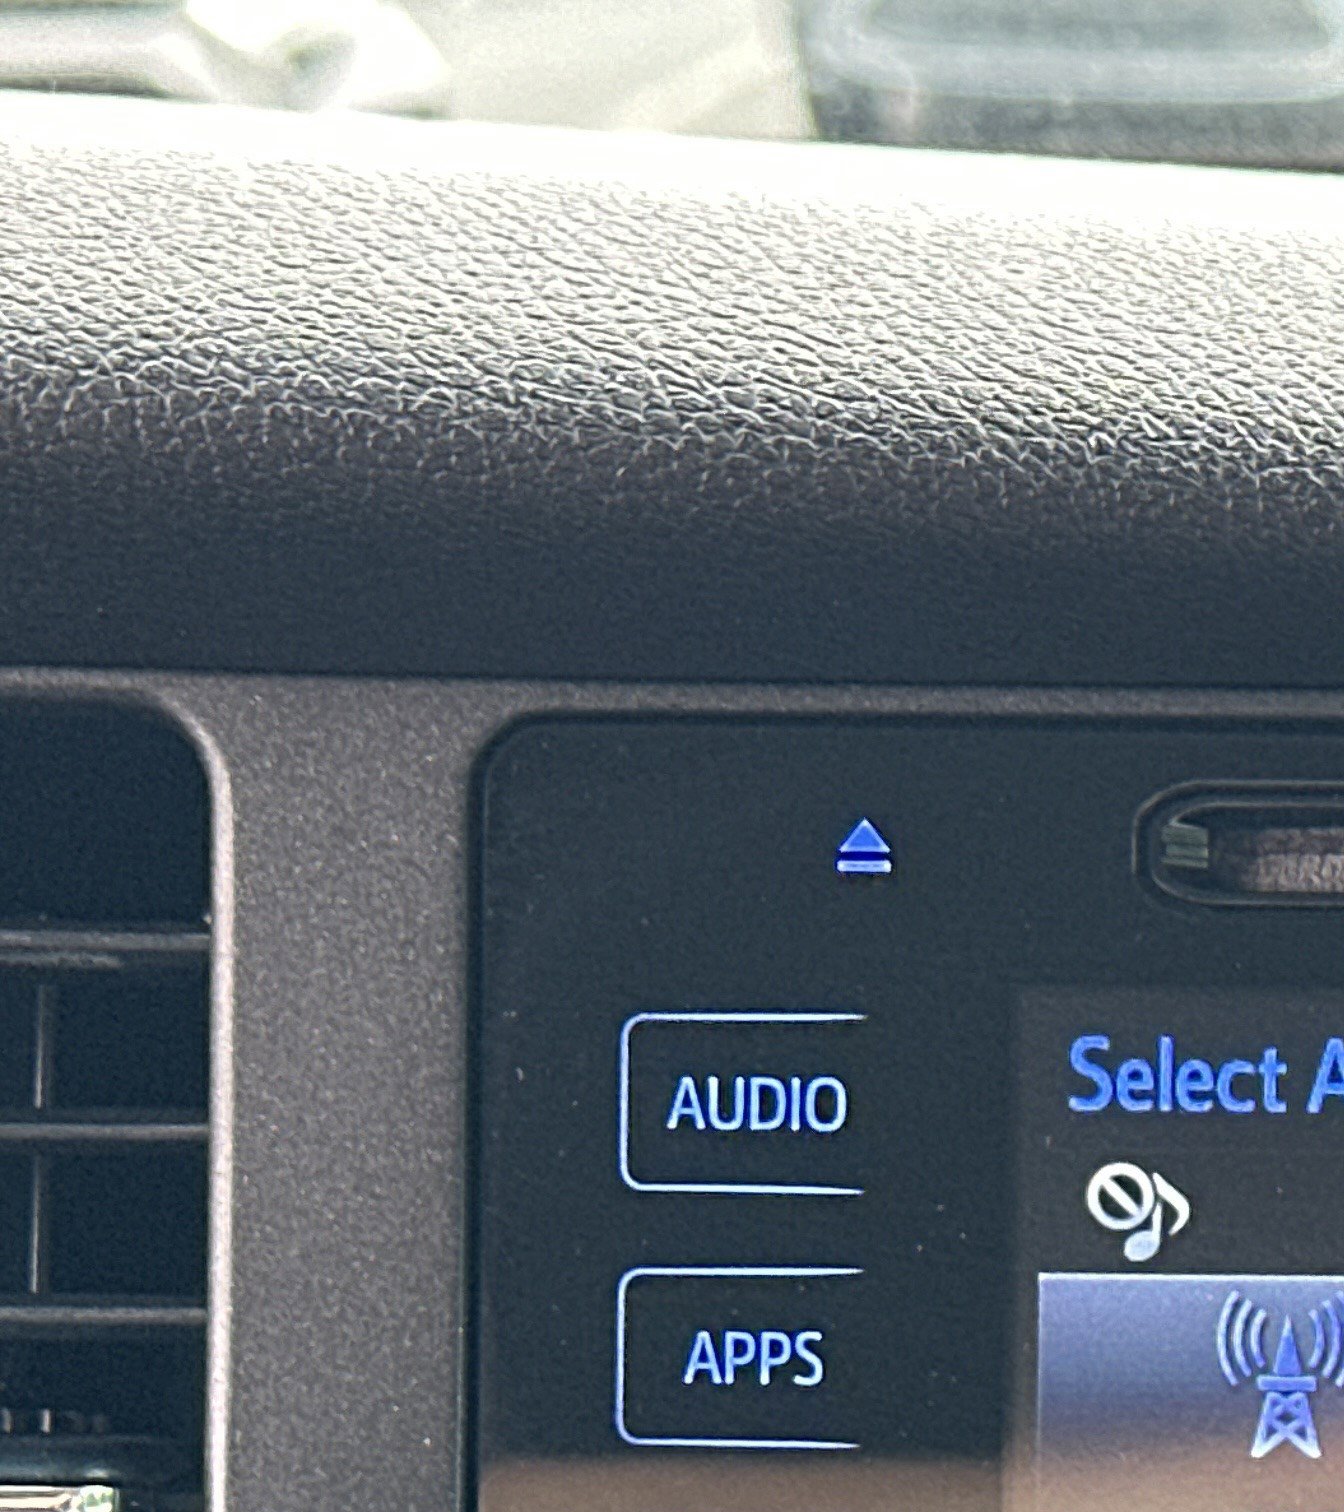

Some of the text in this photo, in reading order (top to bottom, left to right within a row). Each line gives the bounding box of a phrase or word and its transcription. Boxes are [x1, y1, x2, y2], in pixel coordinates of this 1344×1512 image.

[1068, 1035, 1286, 1113] Select
[667, 1076, 847, 1131] AUDIO
[683, 1331, 823, 1386] APPS
